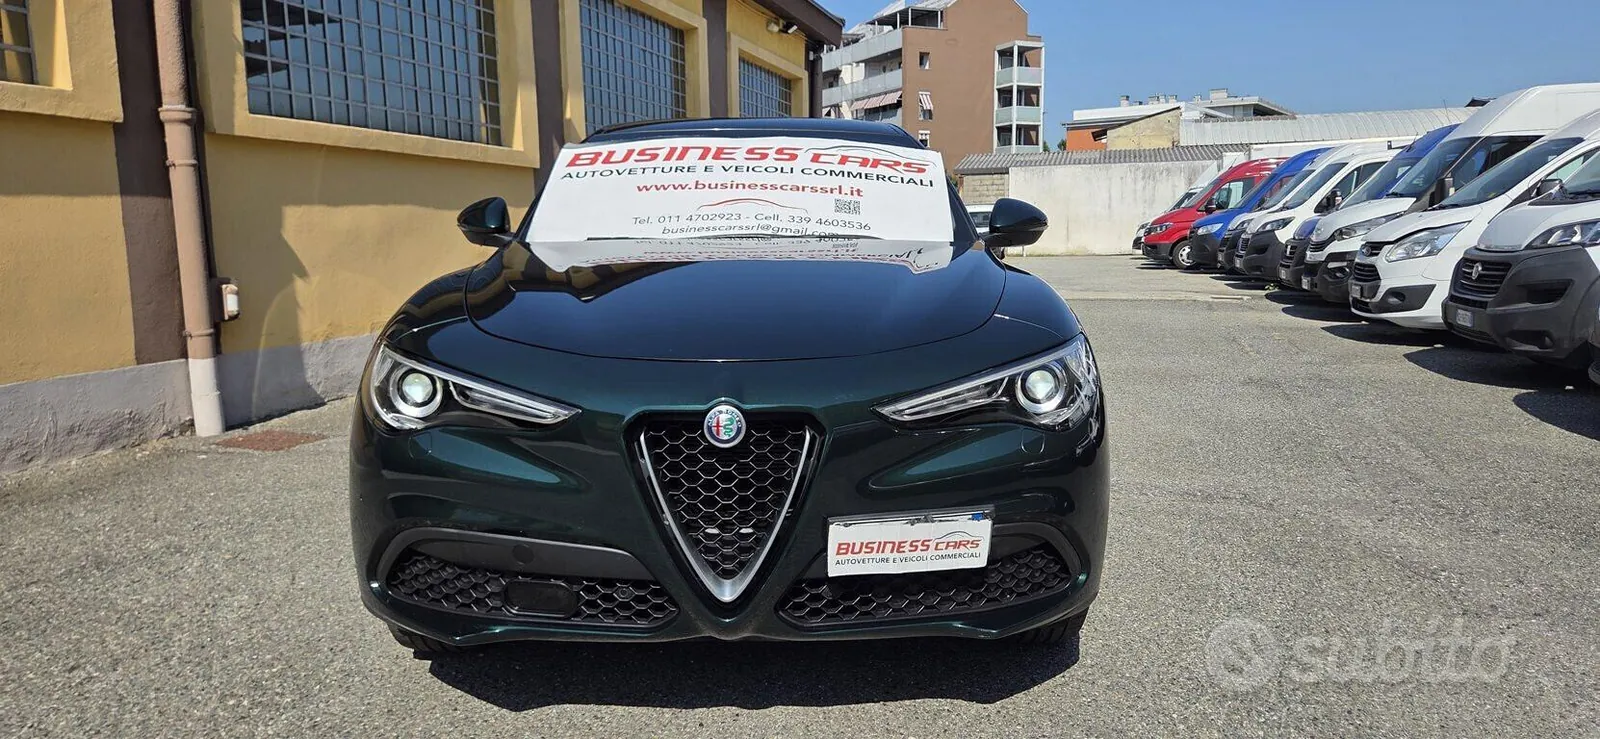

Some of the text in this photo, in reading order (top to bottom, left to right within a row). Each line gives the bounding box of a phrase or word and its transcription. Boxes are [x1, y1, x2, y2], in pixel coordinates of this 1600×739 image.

[566, 145, 931, 174] BUSINESS CARS
[560, 165, 935, 188] AUTOVETTURE E VEICOLI COMMERCIALI
[636, 180, 864, 198] www.businesscarssrl.it
[632, 215, 653, 226] Tel.
[657, 213, 681, 224] 011
[685, 212, 742, 223] 4702923
[754, 212, 783, 222] Cell.
[787, 214, 812, 224] 339
[815, 217, 872, 232] 4603536
[836, 539, 982, 556] BUSINESS CARS
[835, 556, 891, 566] AUTOVETTURE
[899, 555, 928, 563] VEICOLI
[930, 552, 981, 562] COMMERCIALI
